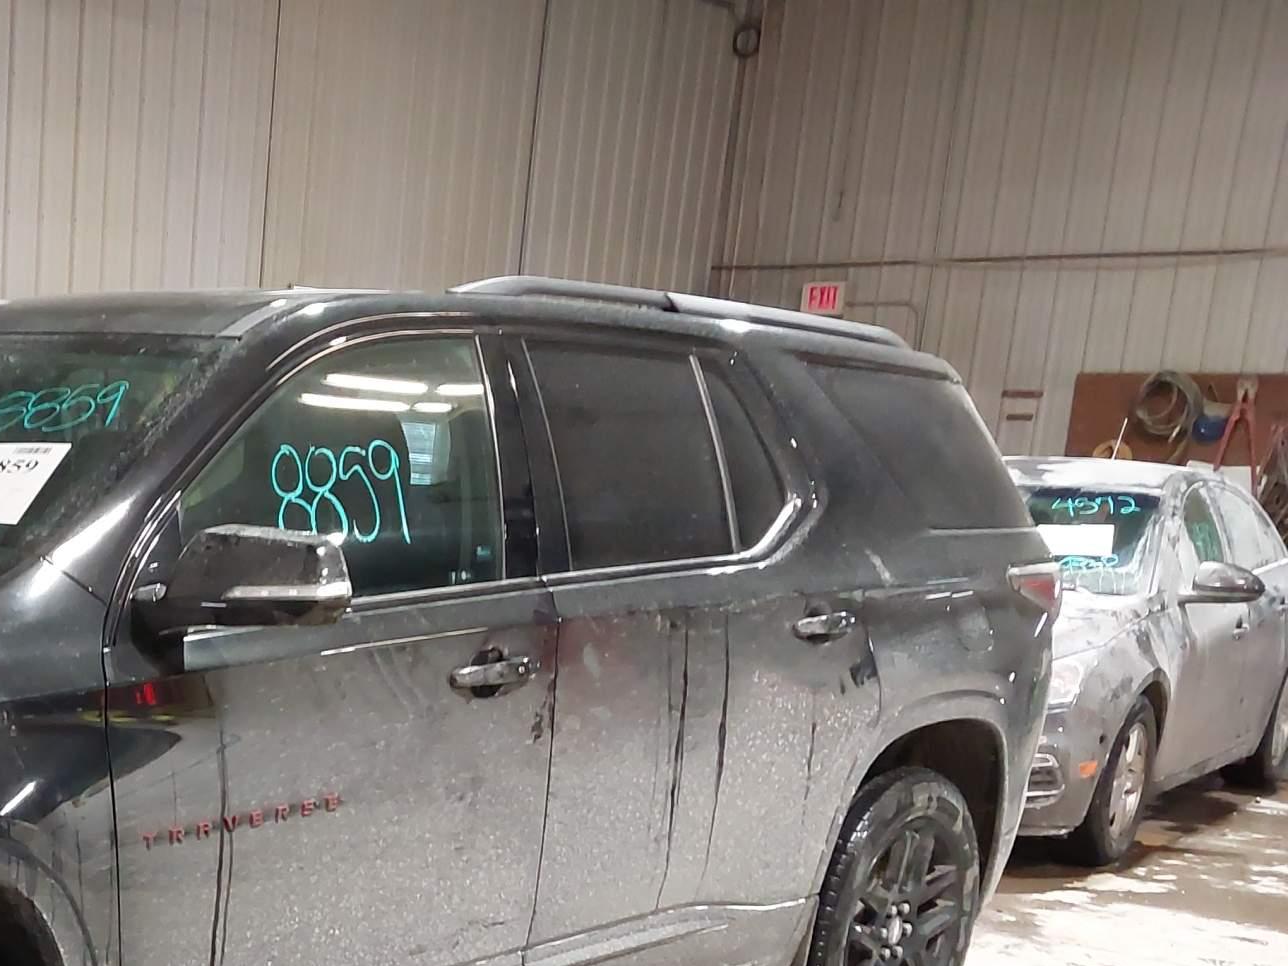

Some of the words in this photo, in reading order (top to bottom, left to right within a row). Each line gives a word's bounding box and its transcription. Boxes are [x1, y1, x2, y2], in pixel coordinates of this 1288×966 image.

[808, 285, 838, 310] EXIT
[271, 438, 411, 545] 8859
[142, 793, 342, 850] TRAVERSE
